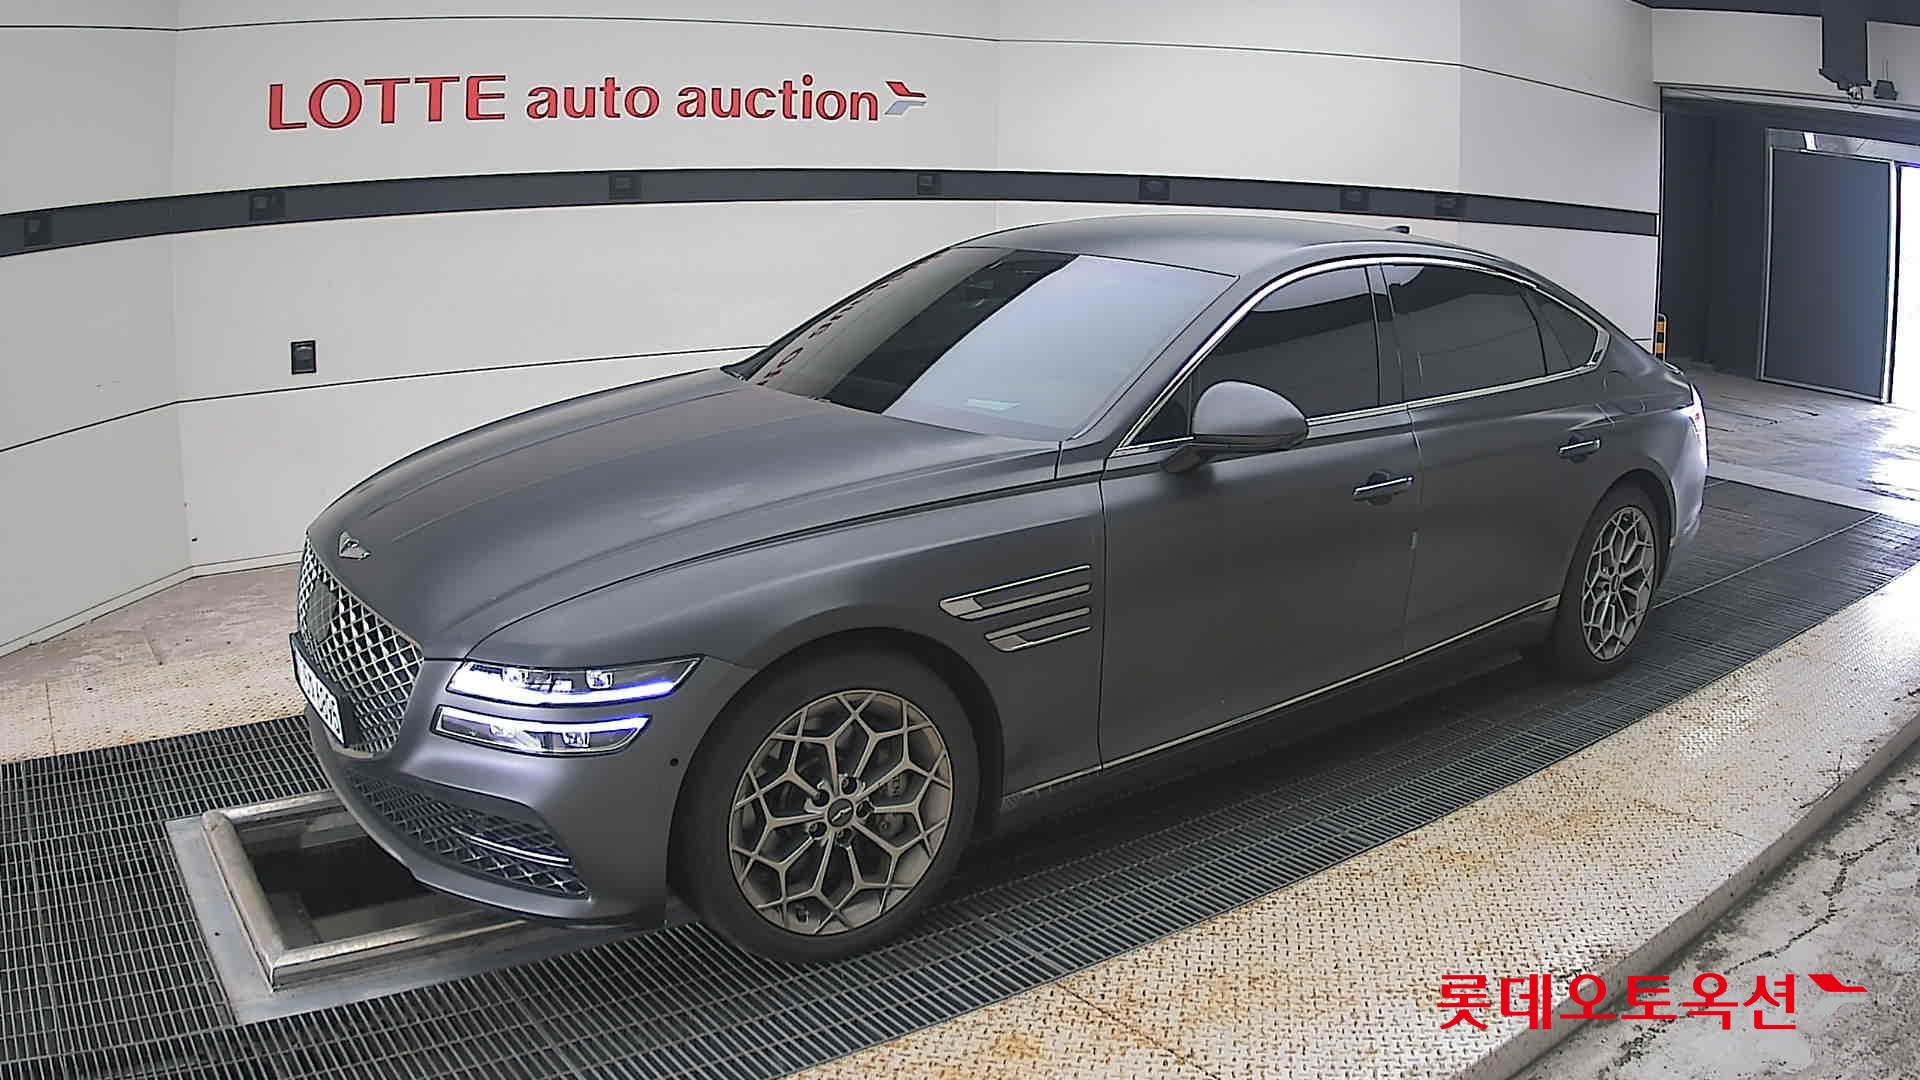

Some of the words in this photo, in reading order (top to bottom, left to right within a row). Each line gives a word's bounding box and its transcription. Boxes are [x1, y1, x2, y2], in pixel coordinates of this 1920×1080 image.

[268, 74, 506, 131] LOTTE
[526, 76, 661, 120] auto
[677, 74, 879, 121] auction
